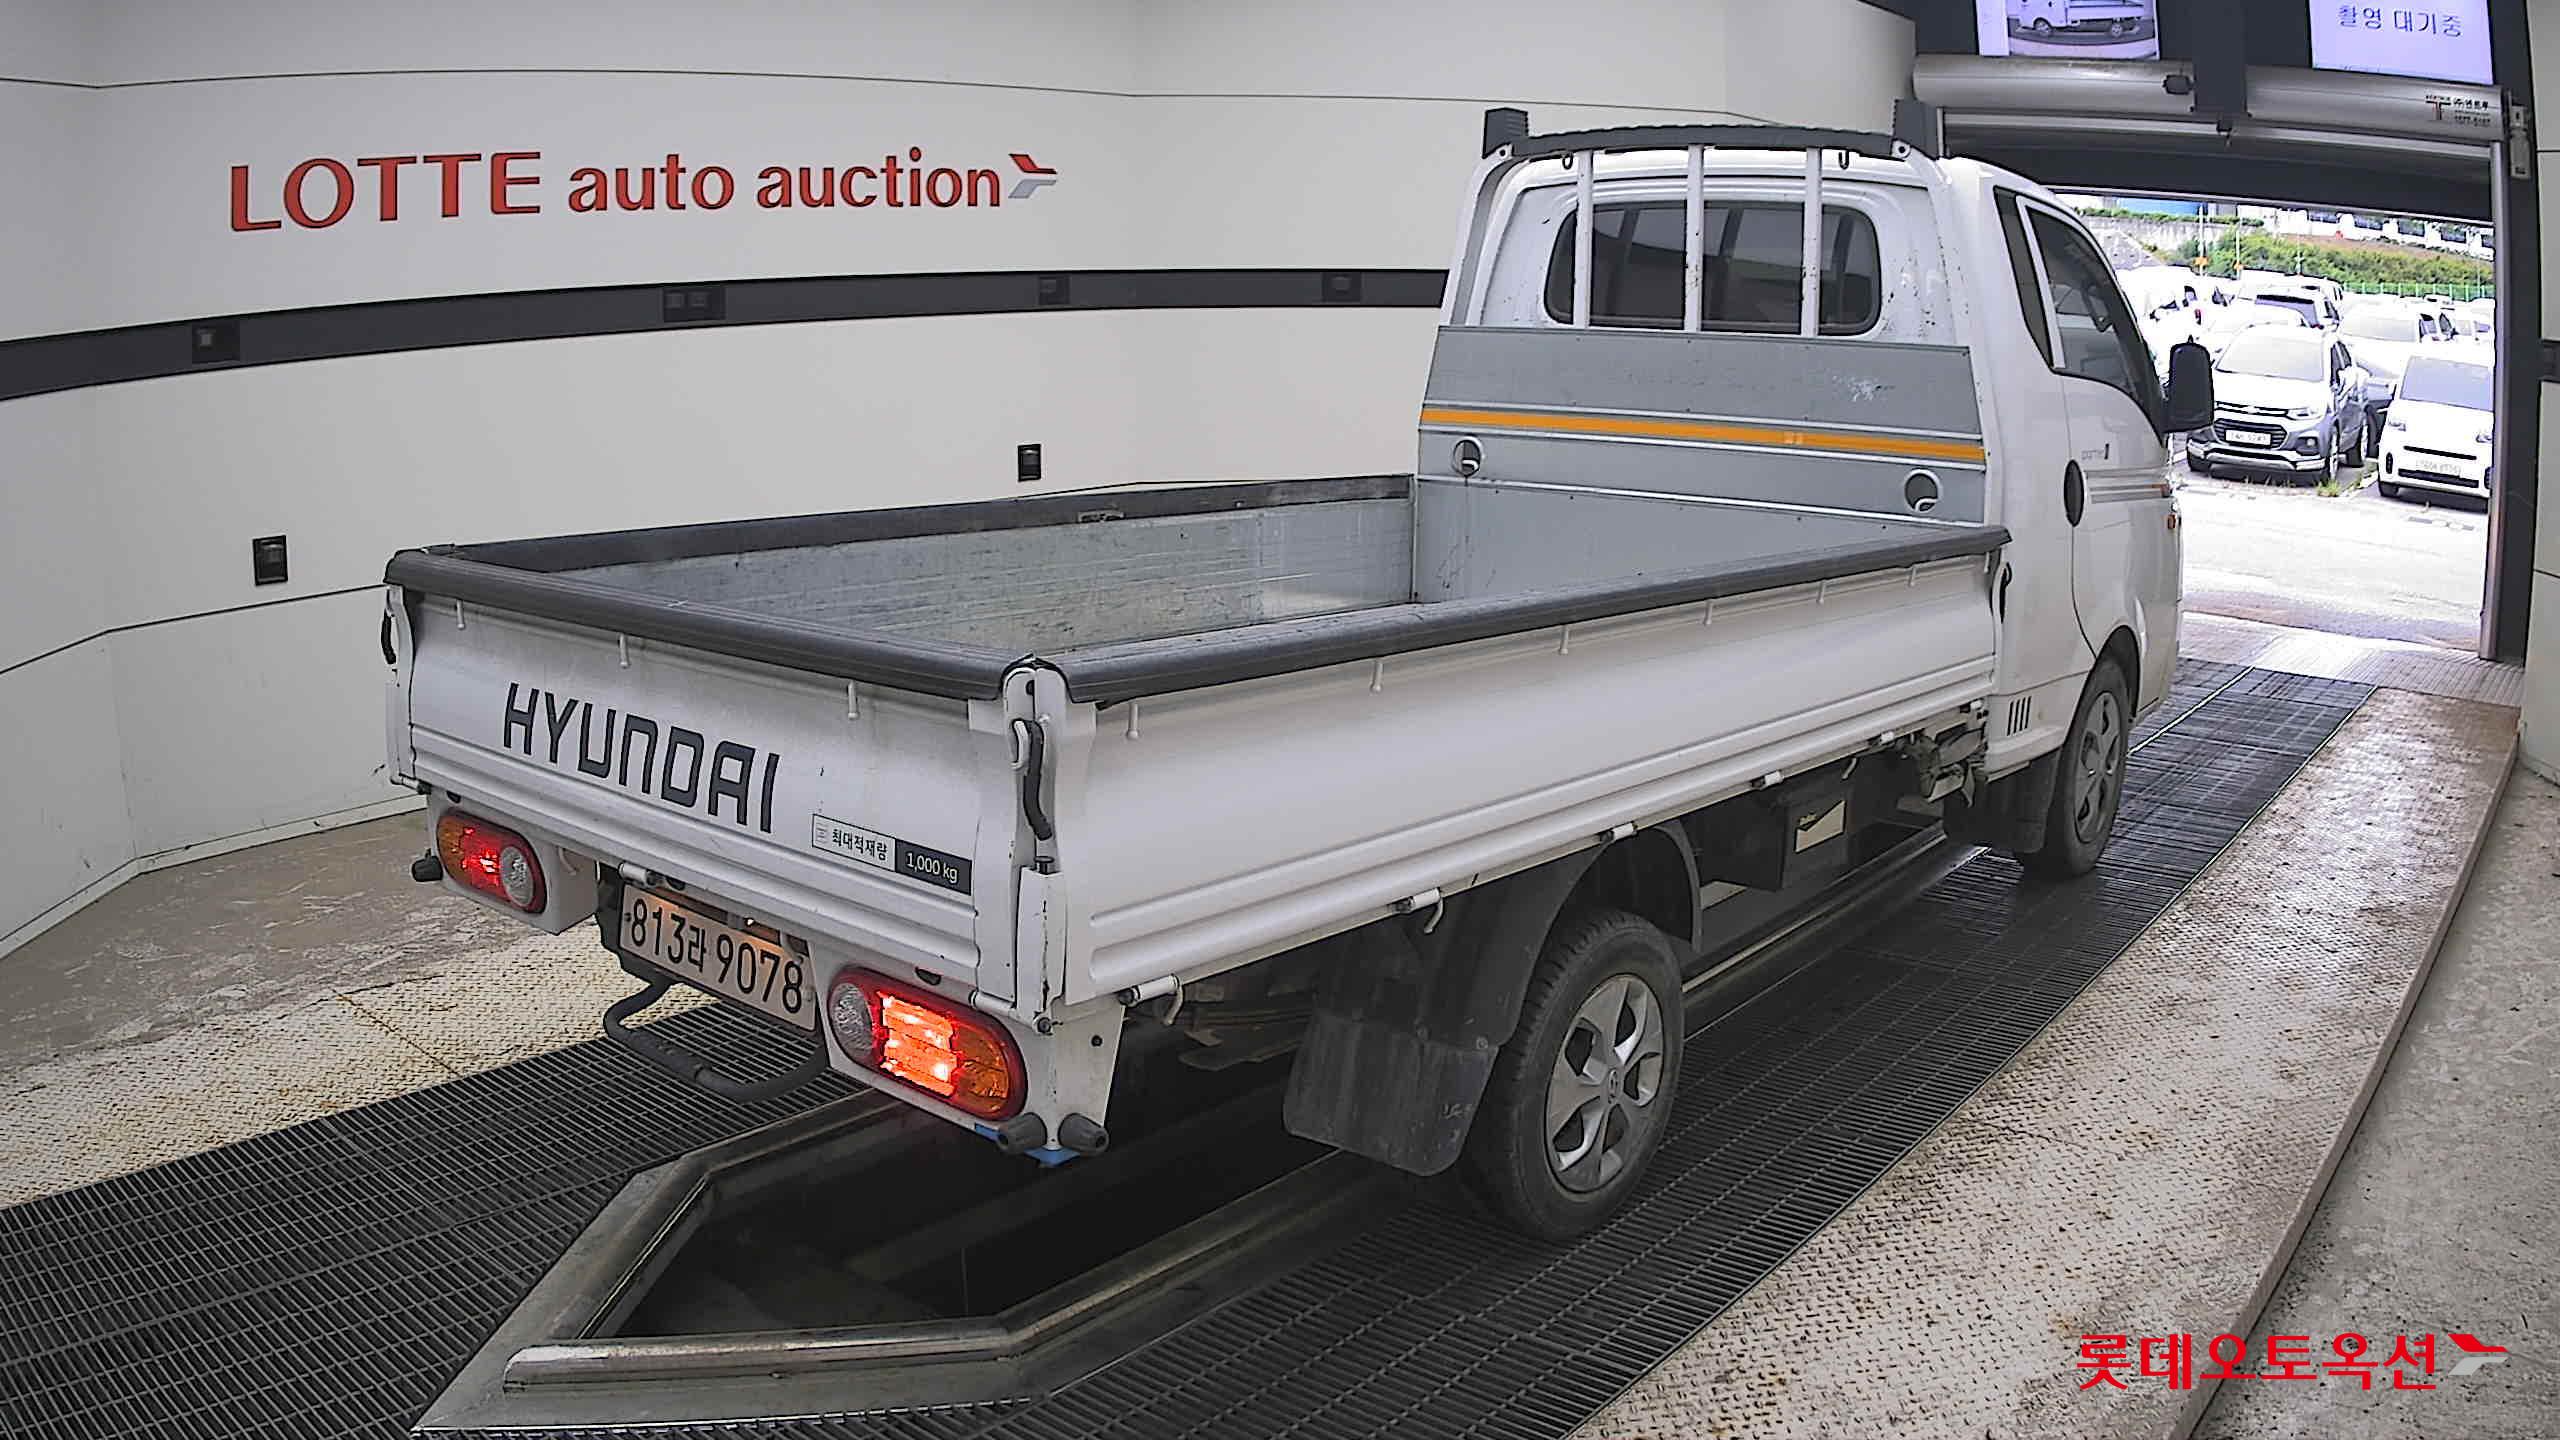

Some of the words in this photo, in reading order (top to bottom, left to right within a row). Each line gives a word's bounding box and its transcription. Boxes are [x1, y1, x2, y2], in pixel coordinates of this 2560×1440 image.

[2338, 5, 2382, 29] 촬영
[2393, 10, 2462, 38] 대기중
[231, 151, 541, 231] LOTTE
[568, 153, 735, 211] auto
[757, 147, 1001, 208] auction
[503, 682, 781, 834] HYUNDAI
[832, 828, 888, 861] 최대적재량
[906, 852, 941, 875] 1,000
[943, 862, 958, 883] kg
[631, 898, 707, 973] 813라
[716, 933, 803, 1013] 9078
